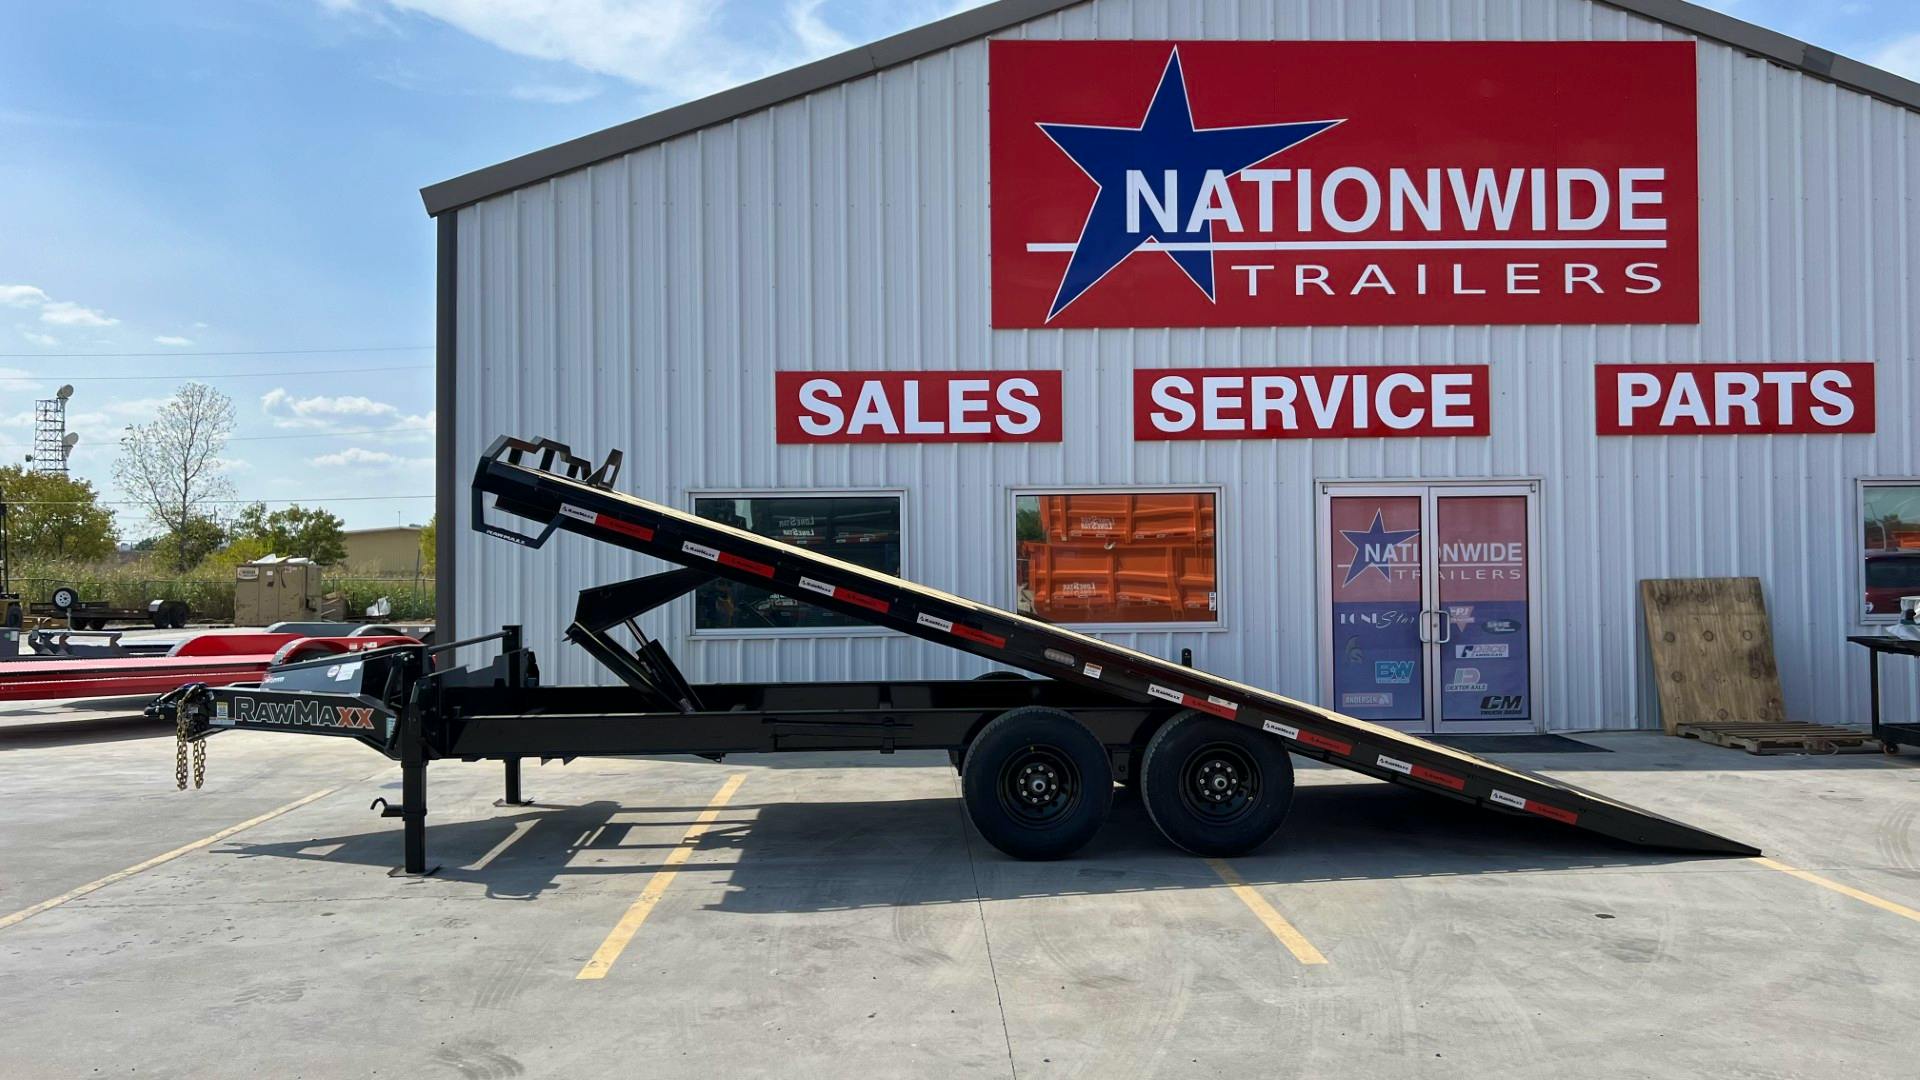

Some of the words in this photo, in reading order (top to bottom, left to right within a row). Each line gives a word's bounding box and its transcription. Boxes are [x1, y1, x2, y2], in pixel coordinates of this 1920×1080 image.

[1125, 166, 1667, 234] NATIONWIDE
[1231, 262, 1662, 297] TRAILERS
[798, 378, 1041, 436] SALES
[1150, 373, 1474, 433] SERVICE
[1617, 369, 1855, 426] PARTS
[1364, 543, 1522, 562] NATINWIDE
